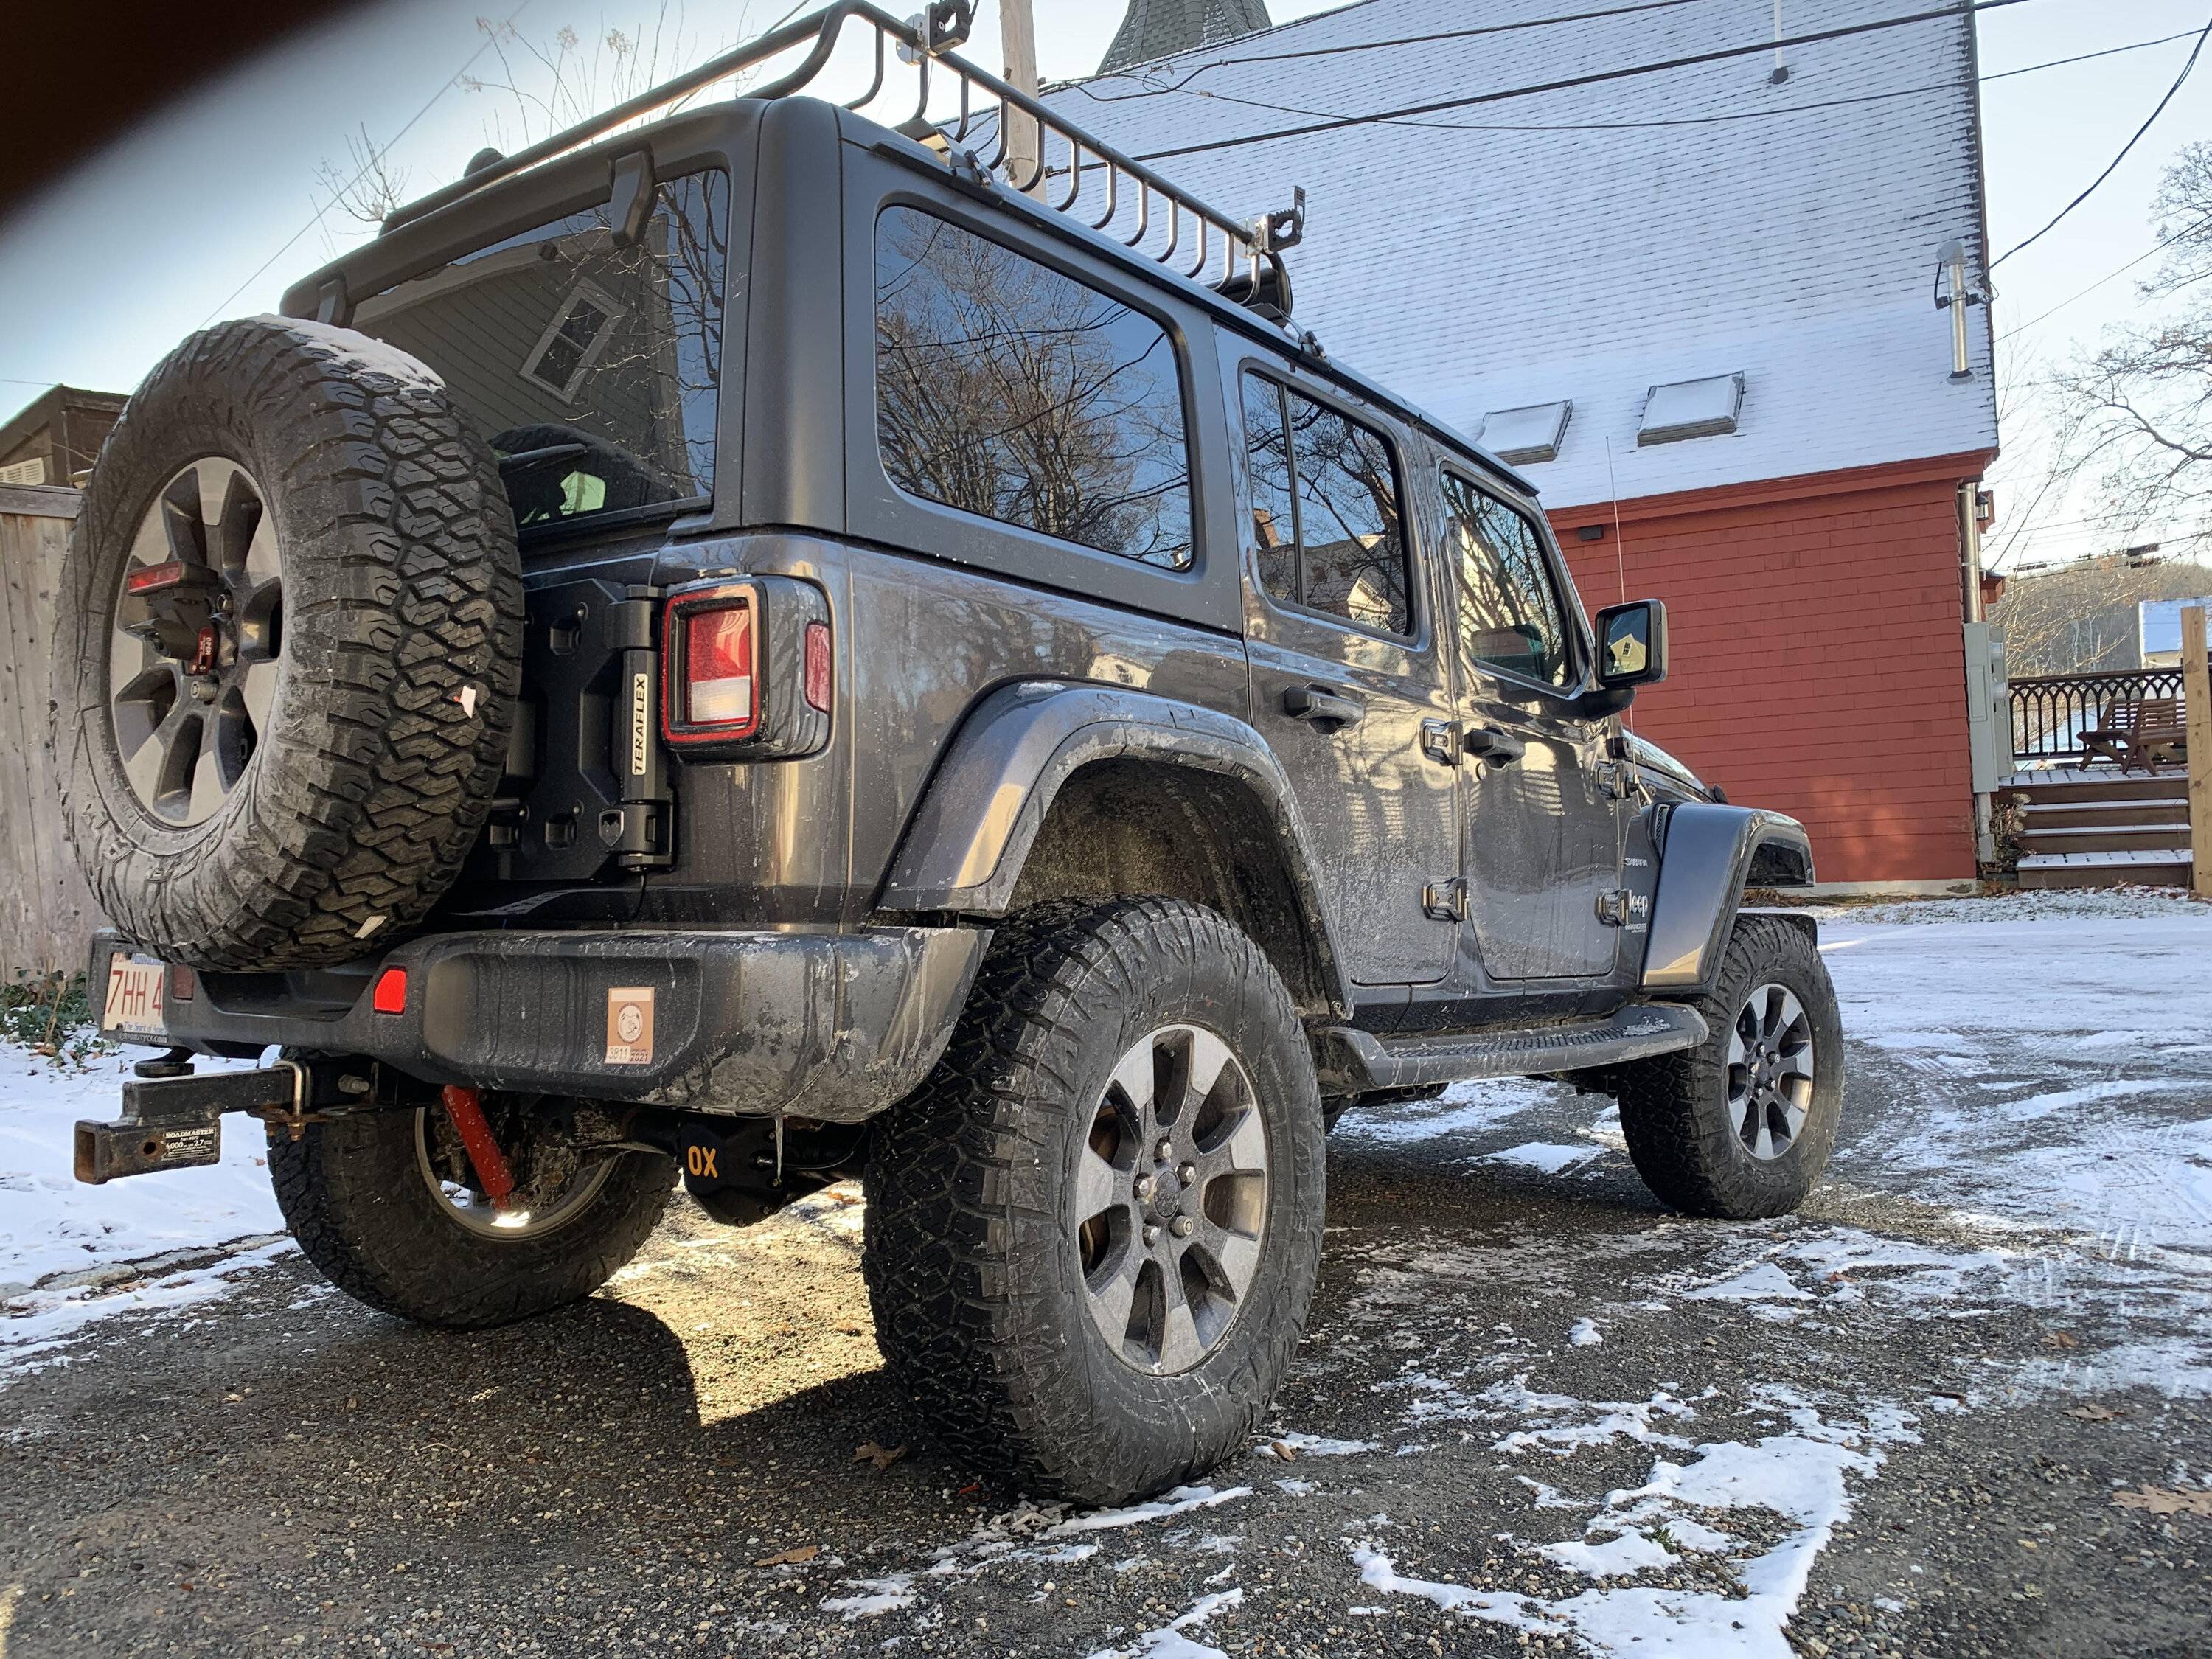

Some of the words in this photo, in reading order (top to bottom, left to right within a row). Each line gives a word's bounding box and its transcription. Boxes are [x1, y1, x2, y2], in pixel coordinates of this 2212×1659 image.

[634, 678, 644, 773] TERAFLEX
[1629, 889, 1648, 917] Jeep
[107, 970, 147, 1016] 7HH
[152, 972, 163, 1016] 4
[630, 1053, 648, 1062] 2021
[165, 1129, 215, 1139] ROADMASTER
[688, 1145, 718, 1178] OX
